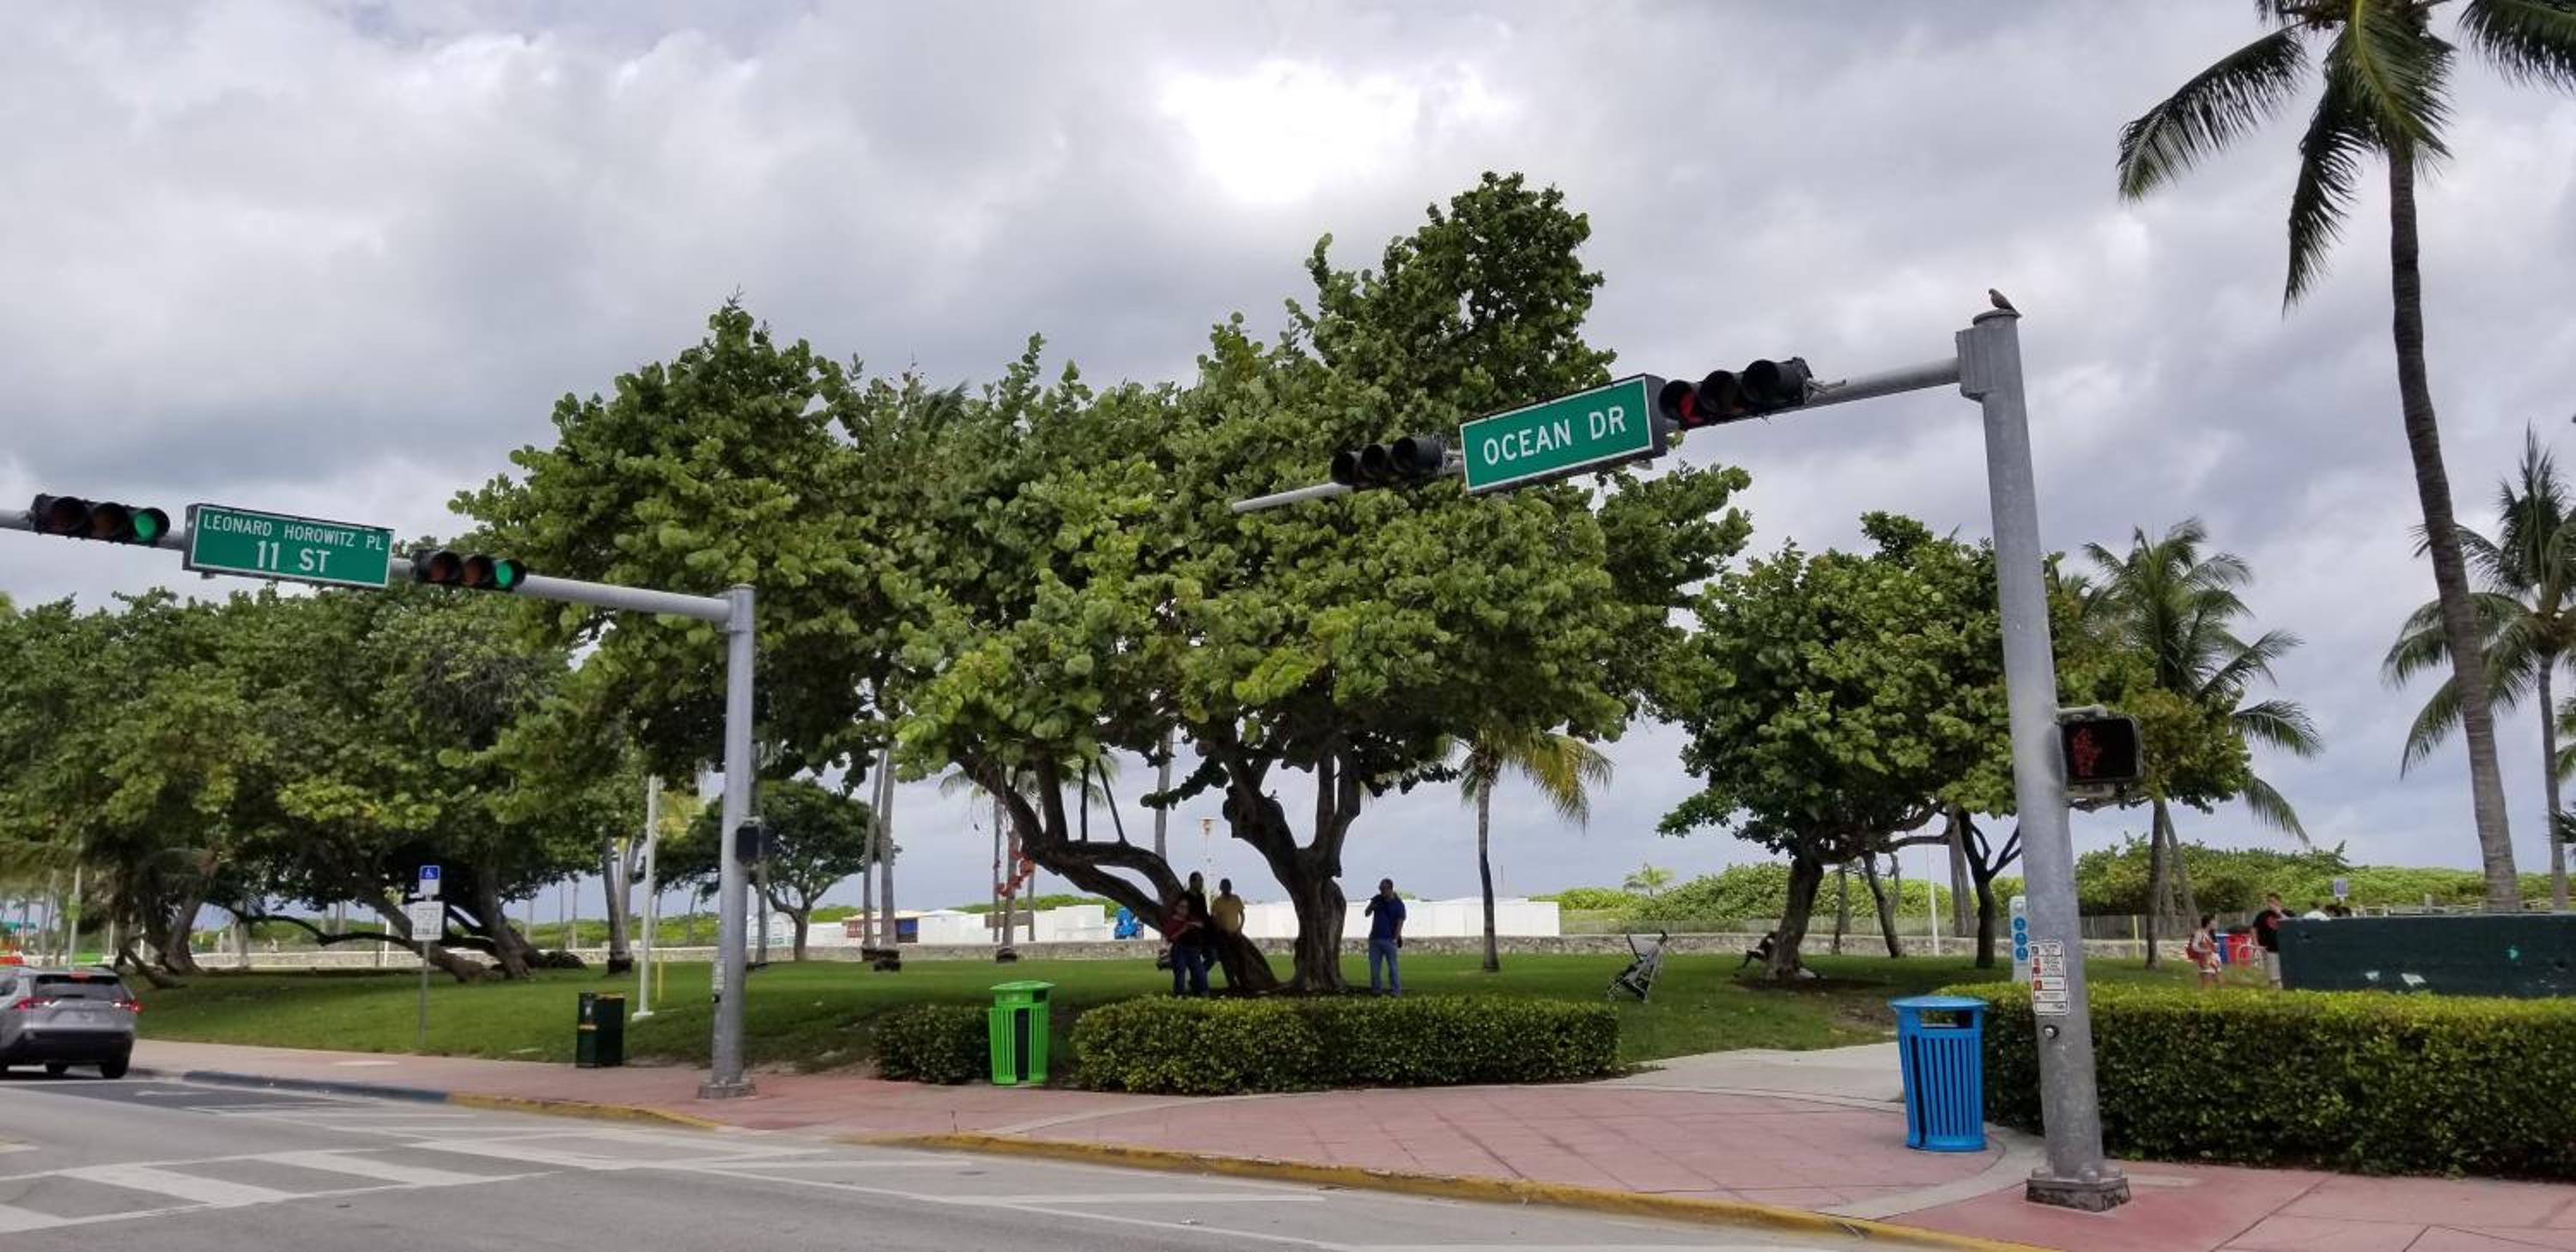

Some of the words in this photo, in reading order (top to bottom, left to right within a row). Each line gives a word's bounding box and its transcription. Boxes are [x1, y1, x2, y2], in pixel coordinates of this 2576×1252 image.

[1483, 418, 1572, 465] OCEAN
[1589, 405, 1626, 441] DR
[204, 514, 272, 536] LEONARD
[284, 525, 355, 547] HOROWITZ
[366, 535, 384, 550] PL
[258, 540, 280, 570] 11
[299, 548, 331, 573] ST
